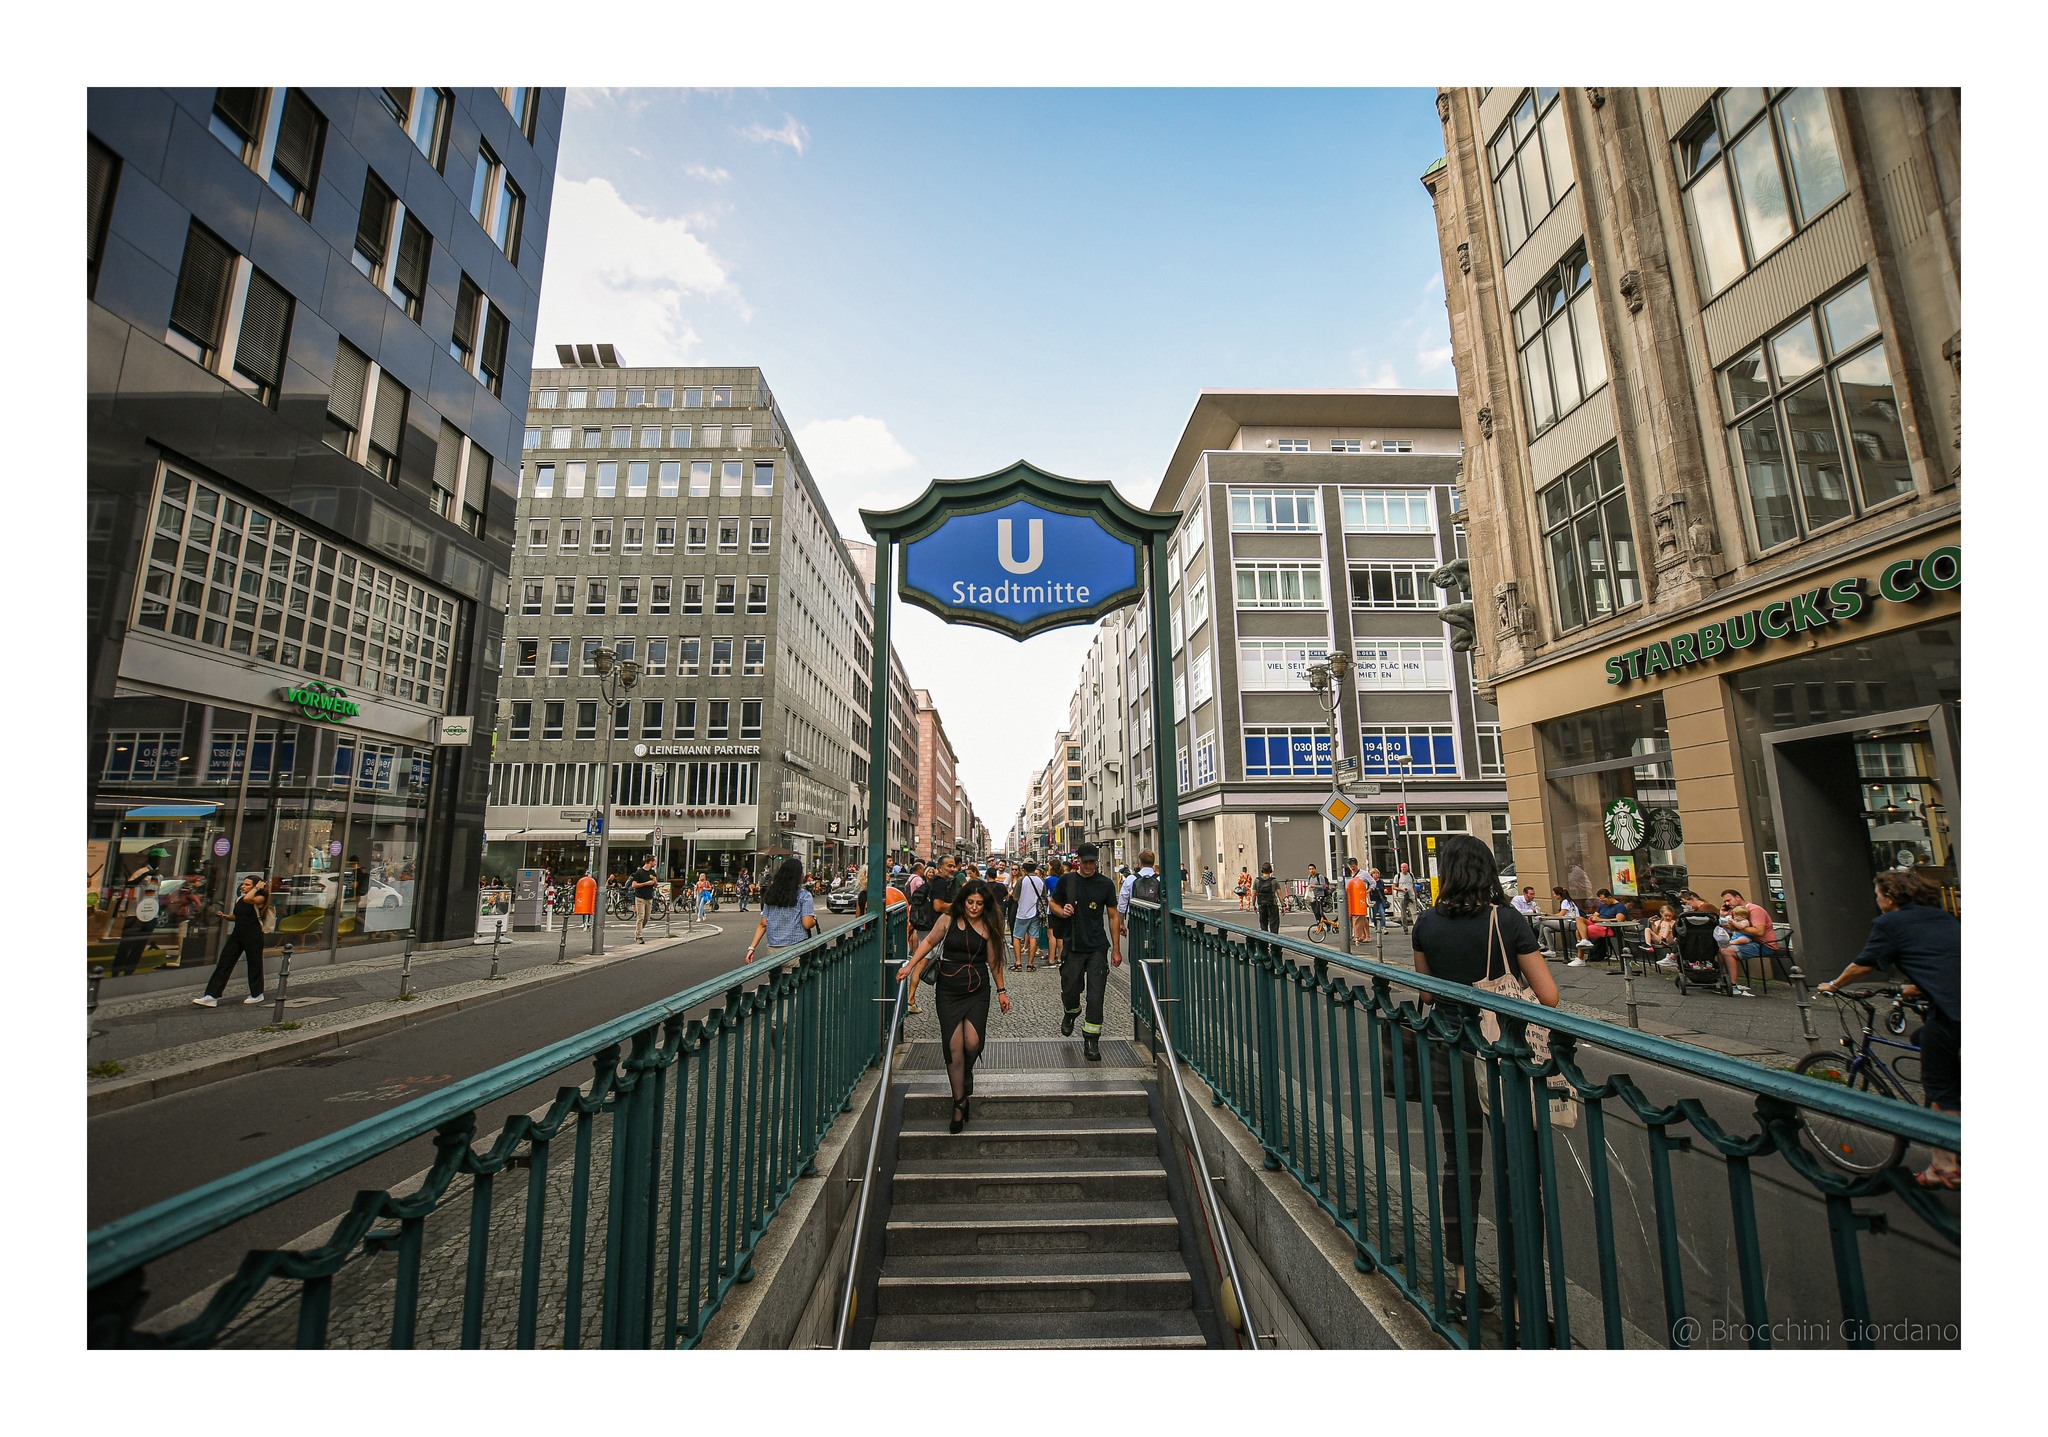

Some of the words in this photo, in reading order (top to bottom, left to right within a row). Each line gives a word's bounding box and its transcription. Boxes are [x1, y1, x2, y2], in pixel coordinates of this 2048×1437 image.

[997, 518, 1044, 575] U
[952, 580, 1090, 604] Stadtmitte
[1605, 577, 1866, 686] STARBUCKS
[286, 686, 361, 717] VORWERK
[650, 745, 712, 755] LEINEMANN
[714, 745, 760, 755] PARTNER
[1294, 743, 1311, 751] 030
[687, 809, 731, 817] KAFFEE
